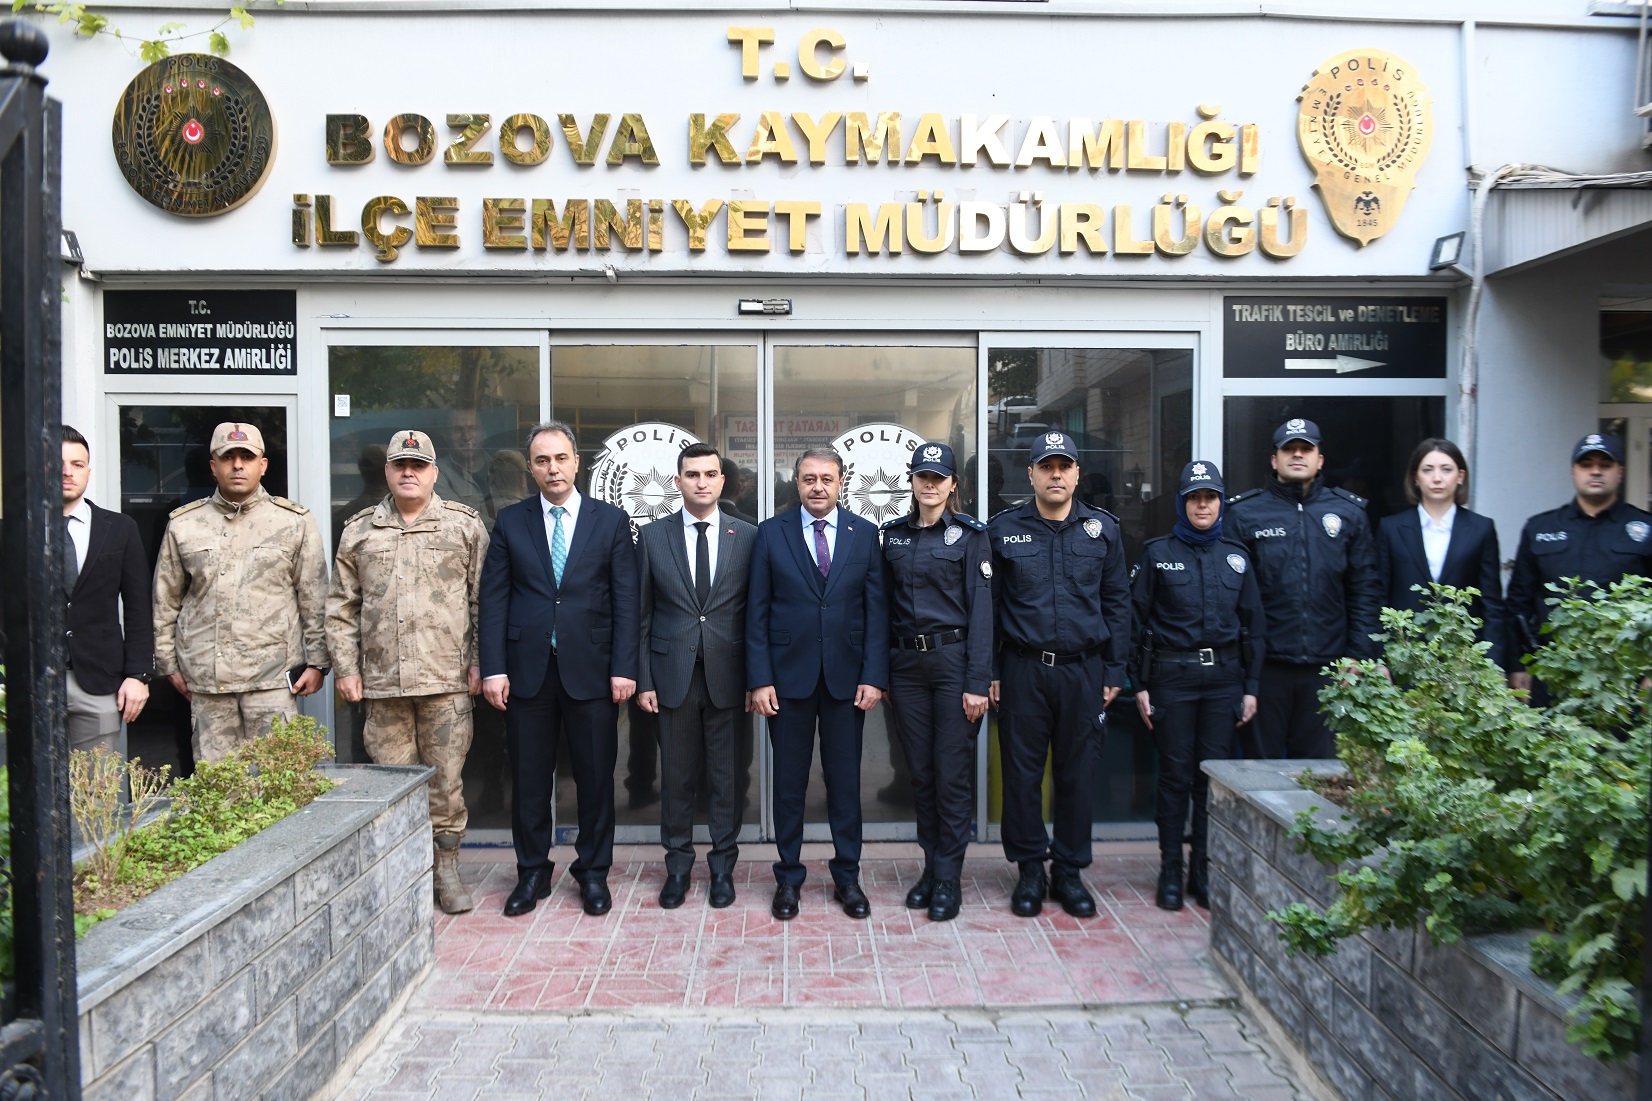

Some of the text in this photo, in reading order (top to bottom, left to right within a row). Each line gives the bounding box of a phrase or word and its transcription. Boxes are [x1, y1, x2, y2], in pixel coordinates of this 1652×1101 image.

[727, 26, 869, 82] T.C.
[326, 104, 1259, 176] BOZOVA KAYMAKAMLIĞI
[1343, 170, 1391, 184] GENEL
[845, 189, 1308, 259] MÜDÜRLÜĞÜ
[1356, 219, 1379, 227] 1845
[188, 300, 211, 315] T.C.
[1338, 309, 1355, 322] ve
[1358, 305, 1440, 323] DENETLEME
[106, 323, 156, 338] BOZOVA
[216, 320, 295, 339] MÜDÜRLÜĞÜ
[1285, 330, 1325, 351] BÜRO
[157, 347, 220, 369] MERKEZ
